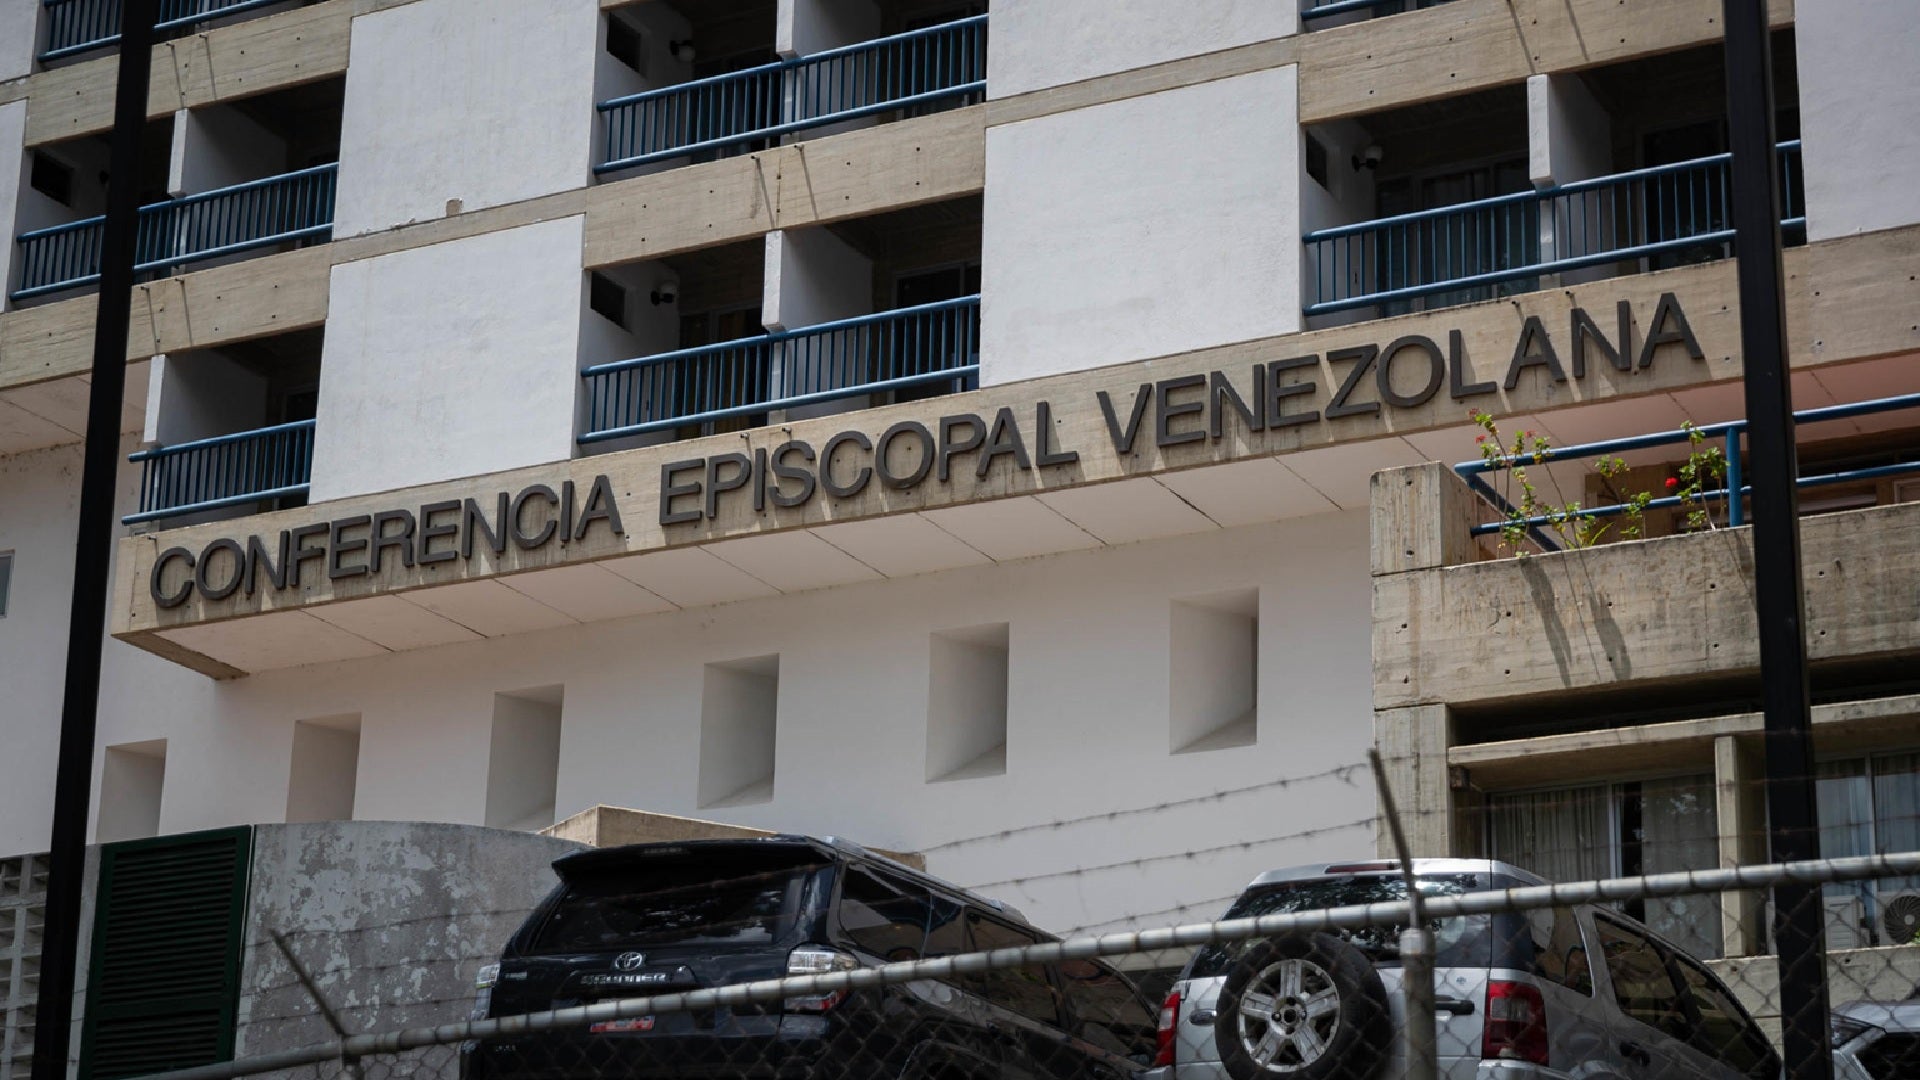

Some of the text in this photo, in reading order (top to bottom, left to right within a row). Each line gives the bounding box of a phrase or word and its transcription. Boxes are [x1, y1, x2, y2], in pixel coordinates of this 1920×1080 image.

[150, 292, 1705, 608] CONFERENCIA EPISCOPAL VENEZOLANA
